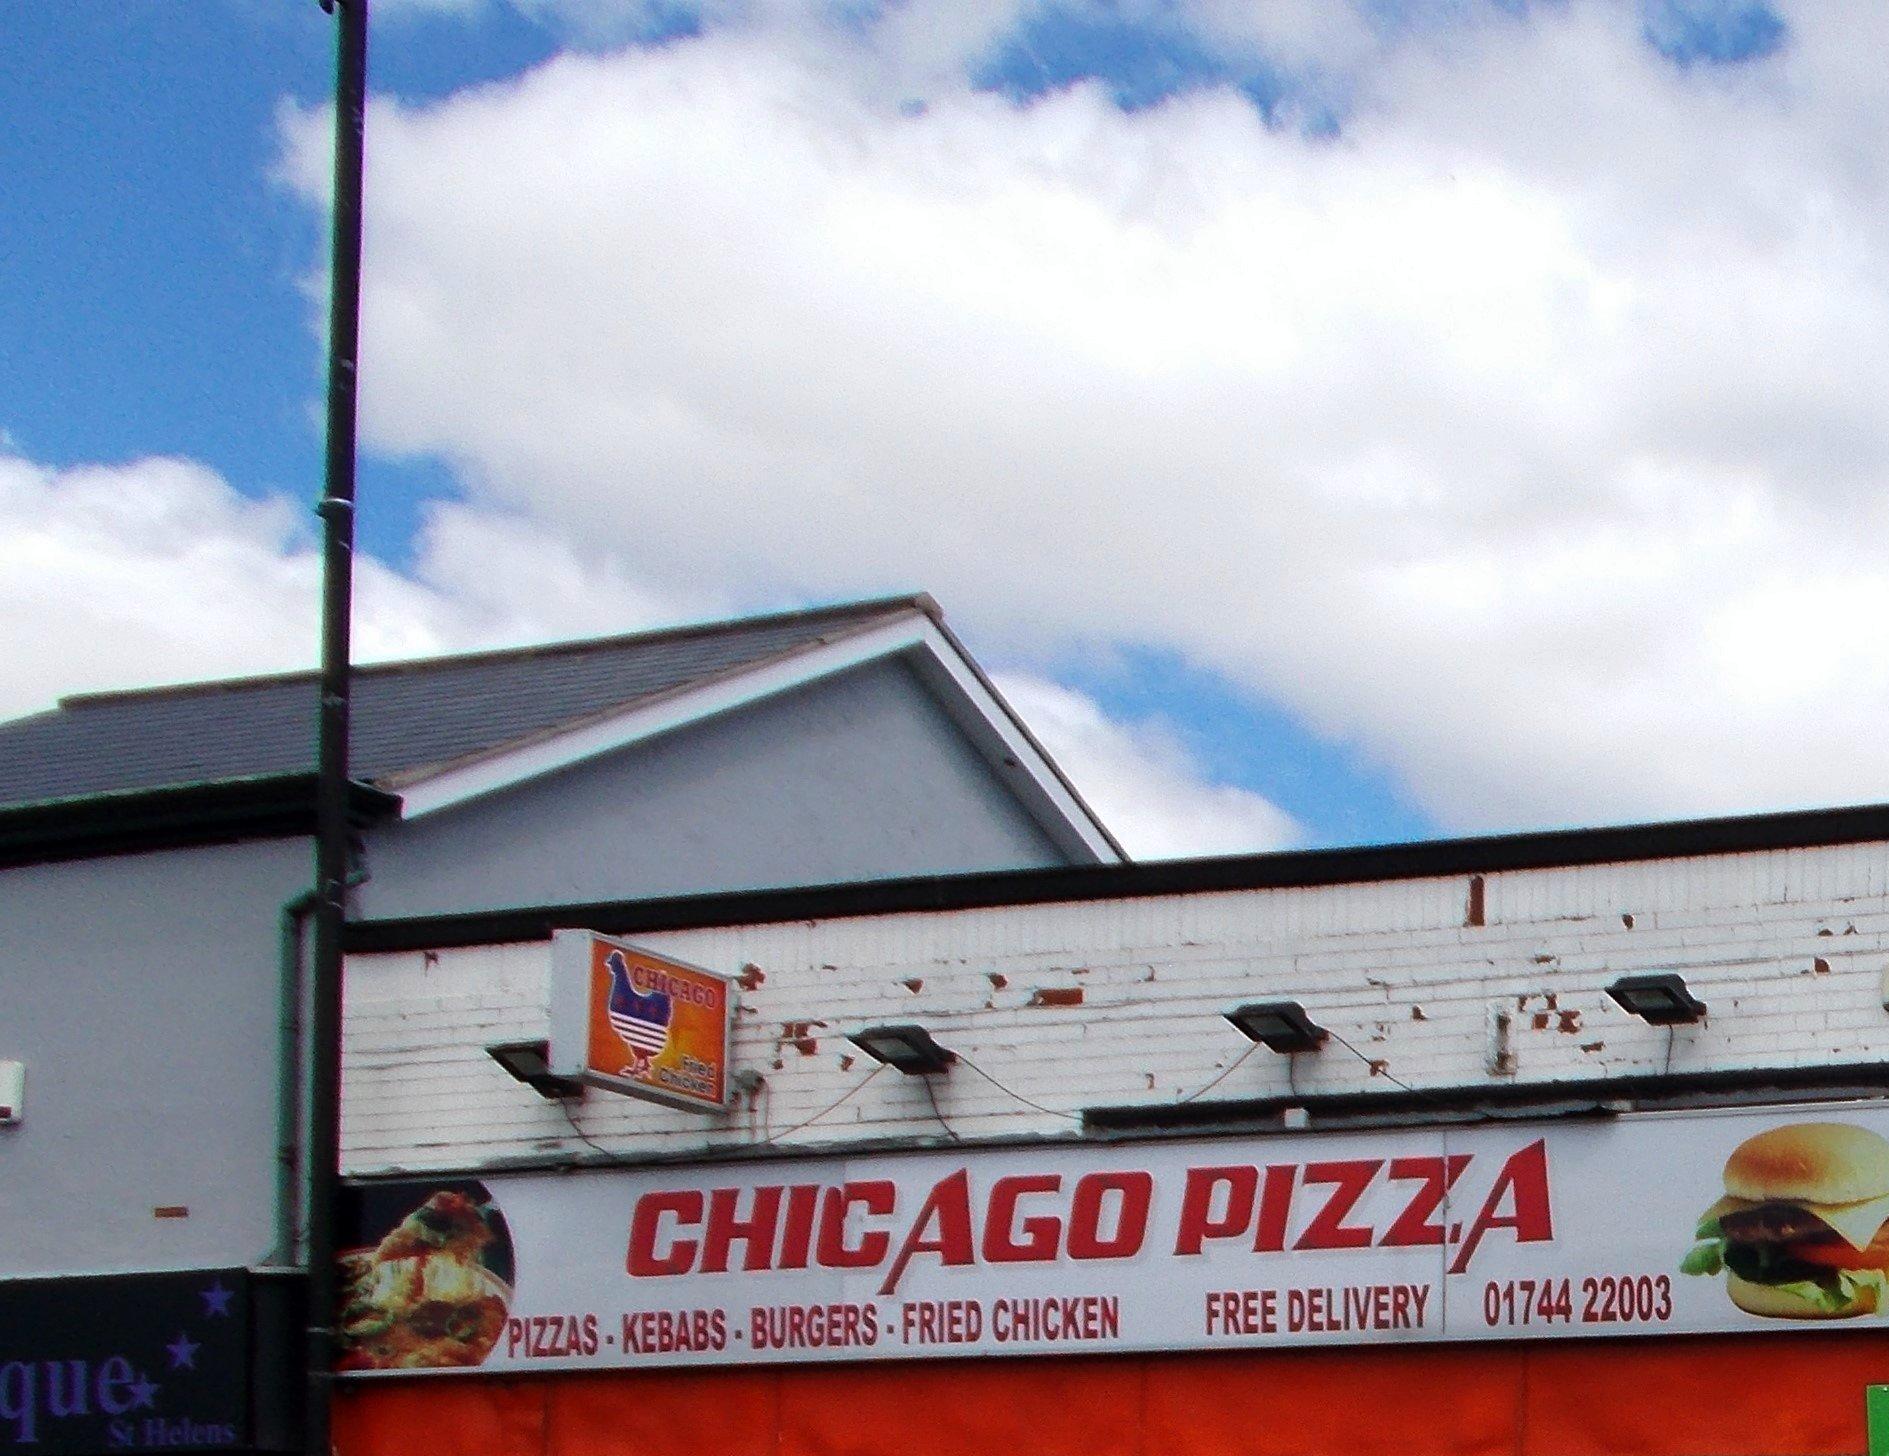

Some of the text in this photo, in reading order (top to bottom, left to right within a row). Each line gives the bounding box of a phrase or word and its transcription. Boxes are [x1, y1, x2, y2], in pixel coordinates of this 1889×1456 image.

[633, 966, 716, 1009] CHICAGO
[625, 1138, 1554, 1296] CHICAGO PIZZA
[507, 1296, 1120, 1359] PIZZAS KEBABS BURGERS FRIED CHICKEN
[1206, 1274, 1672, 1337] FREE DELIVERY 01744 22003
[144, 1417, 237, 1446] Helens
